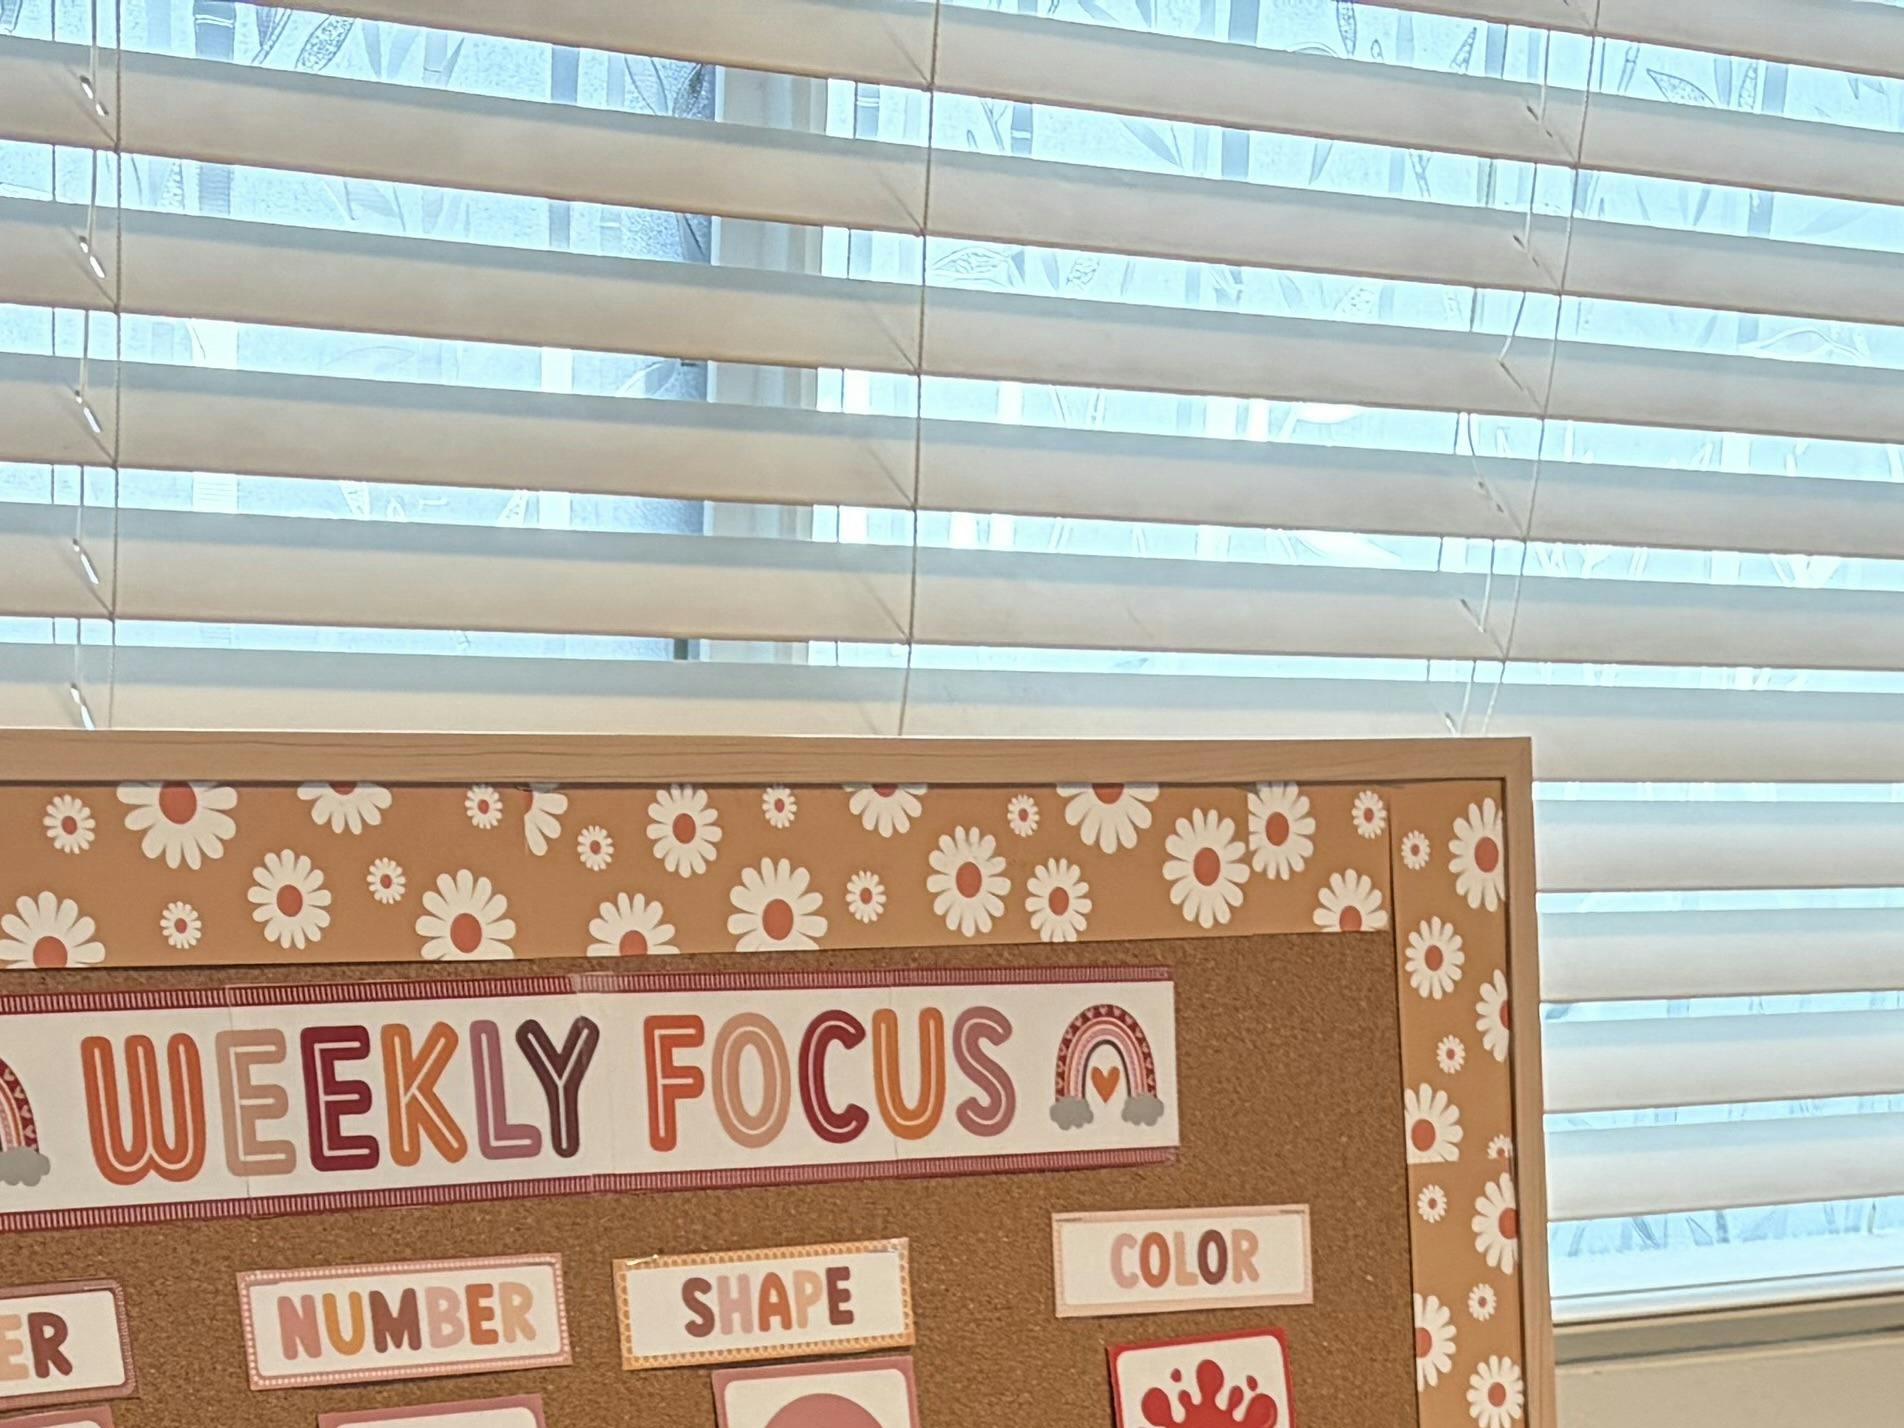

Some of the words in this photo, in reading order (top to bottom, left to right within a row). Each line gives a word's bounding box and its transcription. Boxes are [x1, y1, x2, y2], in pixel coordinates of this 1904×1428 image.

[79, 1014, 599, 1185] WEEKLY
[643, 1007, 1014, 1151] FOCUS
[1110, 1227, 1260, 1290] COLOR
[278, 1280, 538, 1361] NUMBER
[679, 1267, 856, 1338] SHAPE
